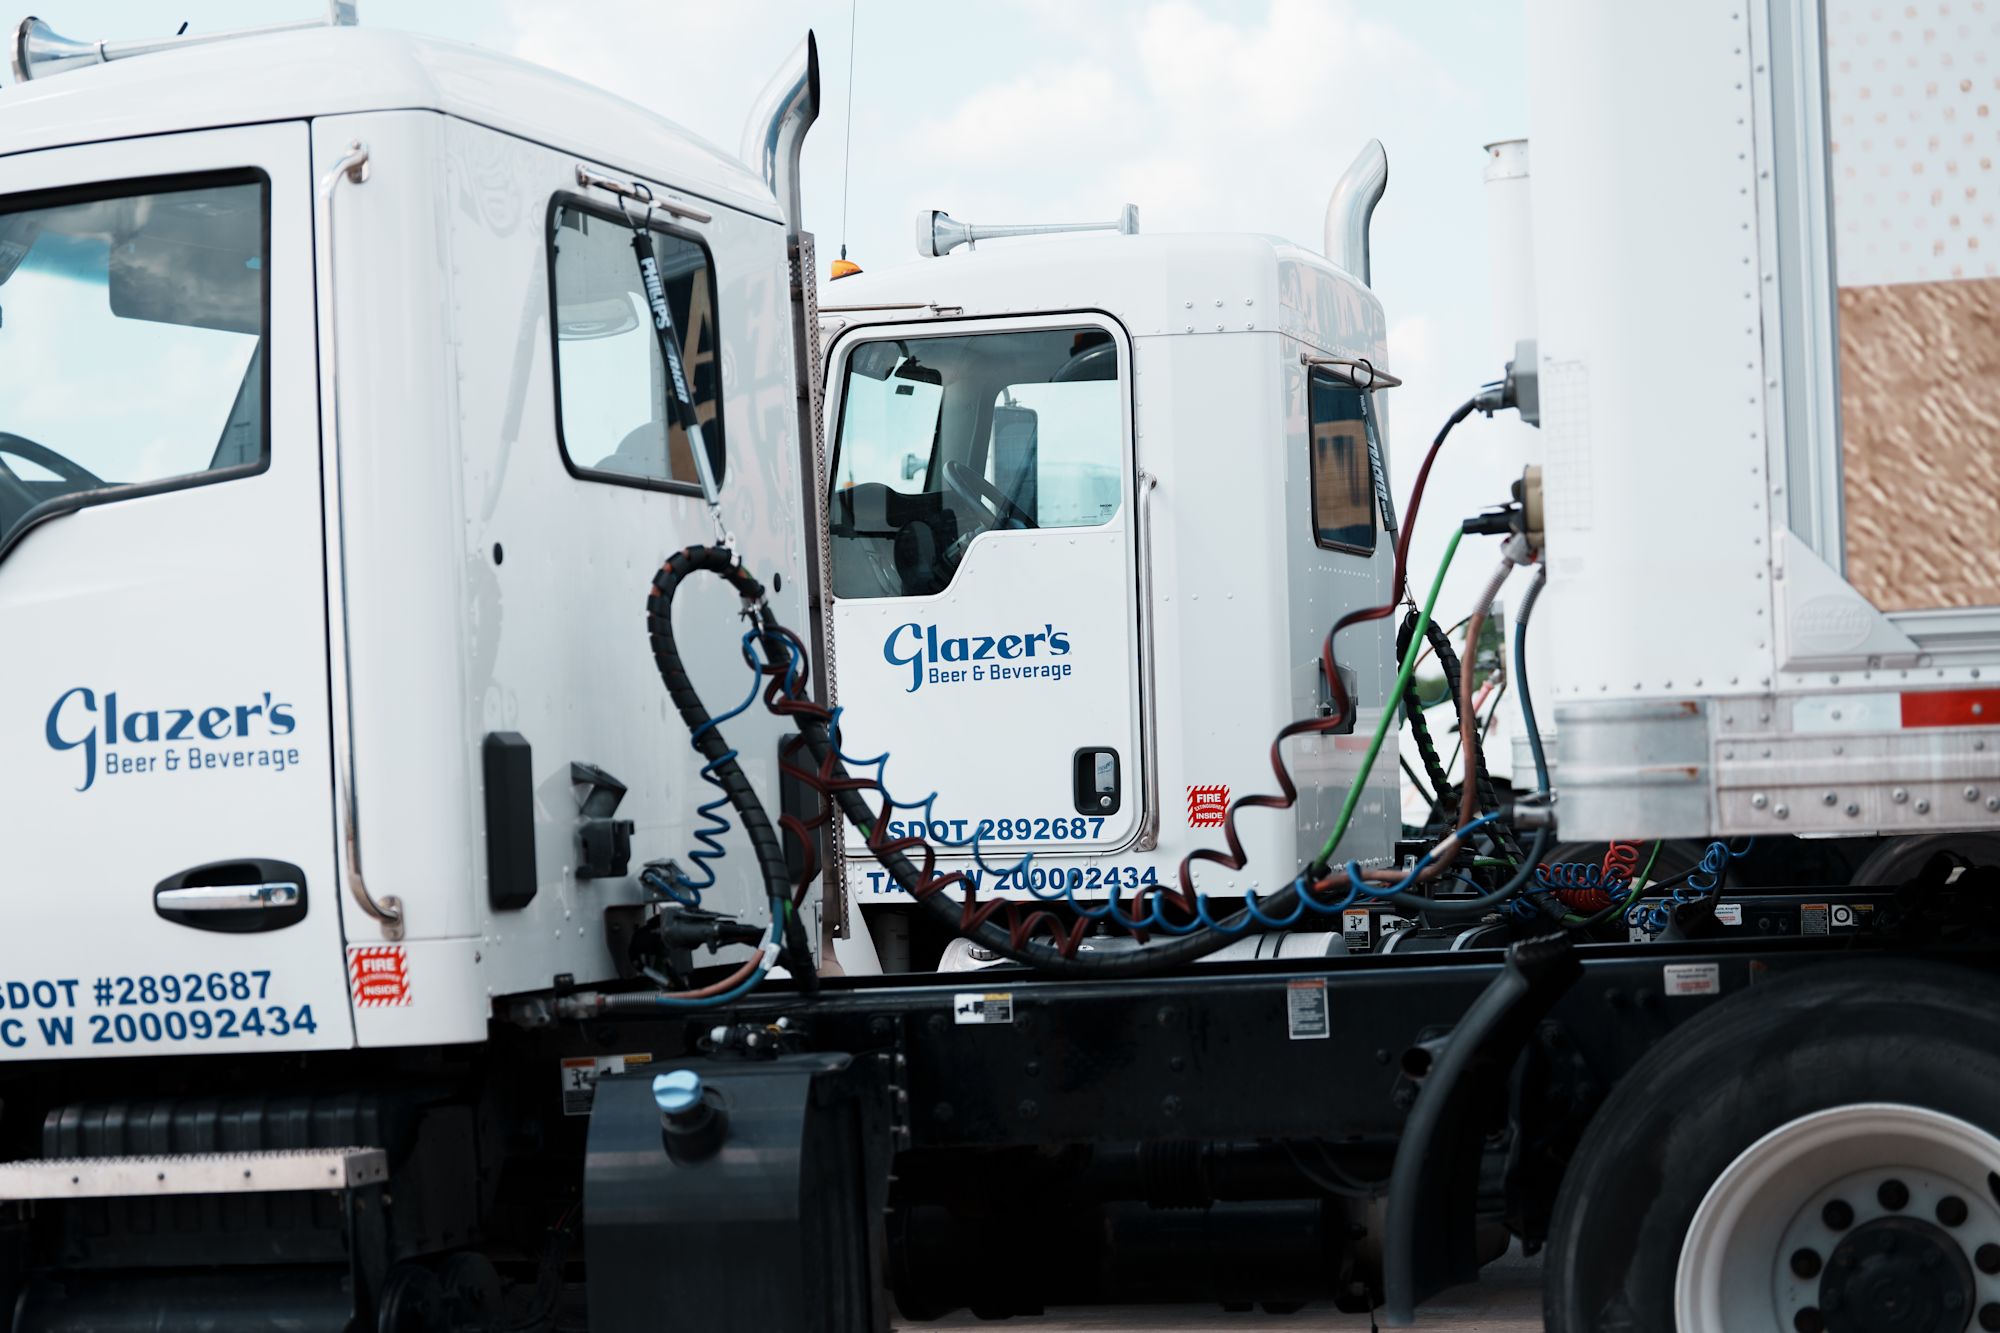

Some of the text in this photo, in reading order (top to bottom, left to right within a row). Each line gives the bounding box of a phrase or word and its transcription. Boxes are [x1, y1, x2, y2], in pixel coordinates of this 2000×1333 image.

[641, 257, 671, 329] PHILLIPS
[667, 354, 689, 404] TRACKER
[1369, 440, 1388, 501] TRACKER
[884, 623, 1070, 693] Glazer's
[929, 663, 1072, 684] Beer & Beverage
[45, 687, 297, 792] Glazer's
[106, 747, 300, 775] Beer & Beverage
[1196, 793, 1222, 803] FIRE
[978, 817, 1106, 841] 2892687
[1195, 811, 1224, 820] INSIDE
[362, 957, 396, 973] FIRE
[0, 970, 272, 1010] DOT #2892687
[363, 984, 401, 996] INSIDE
[37, 1015, 74, 1046] W
[88, 1006, 318, 1045] 200092434
